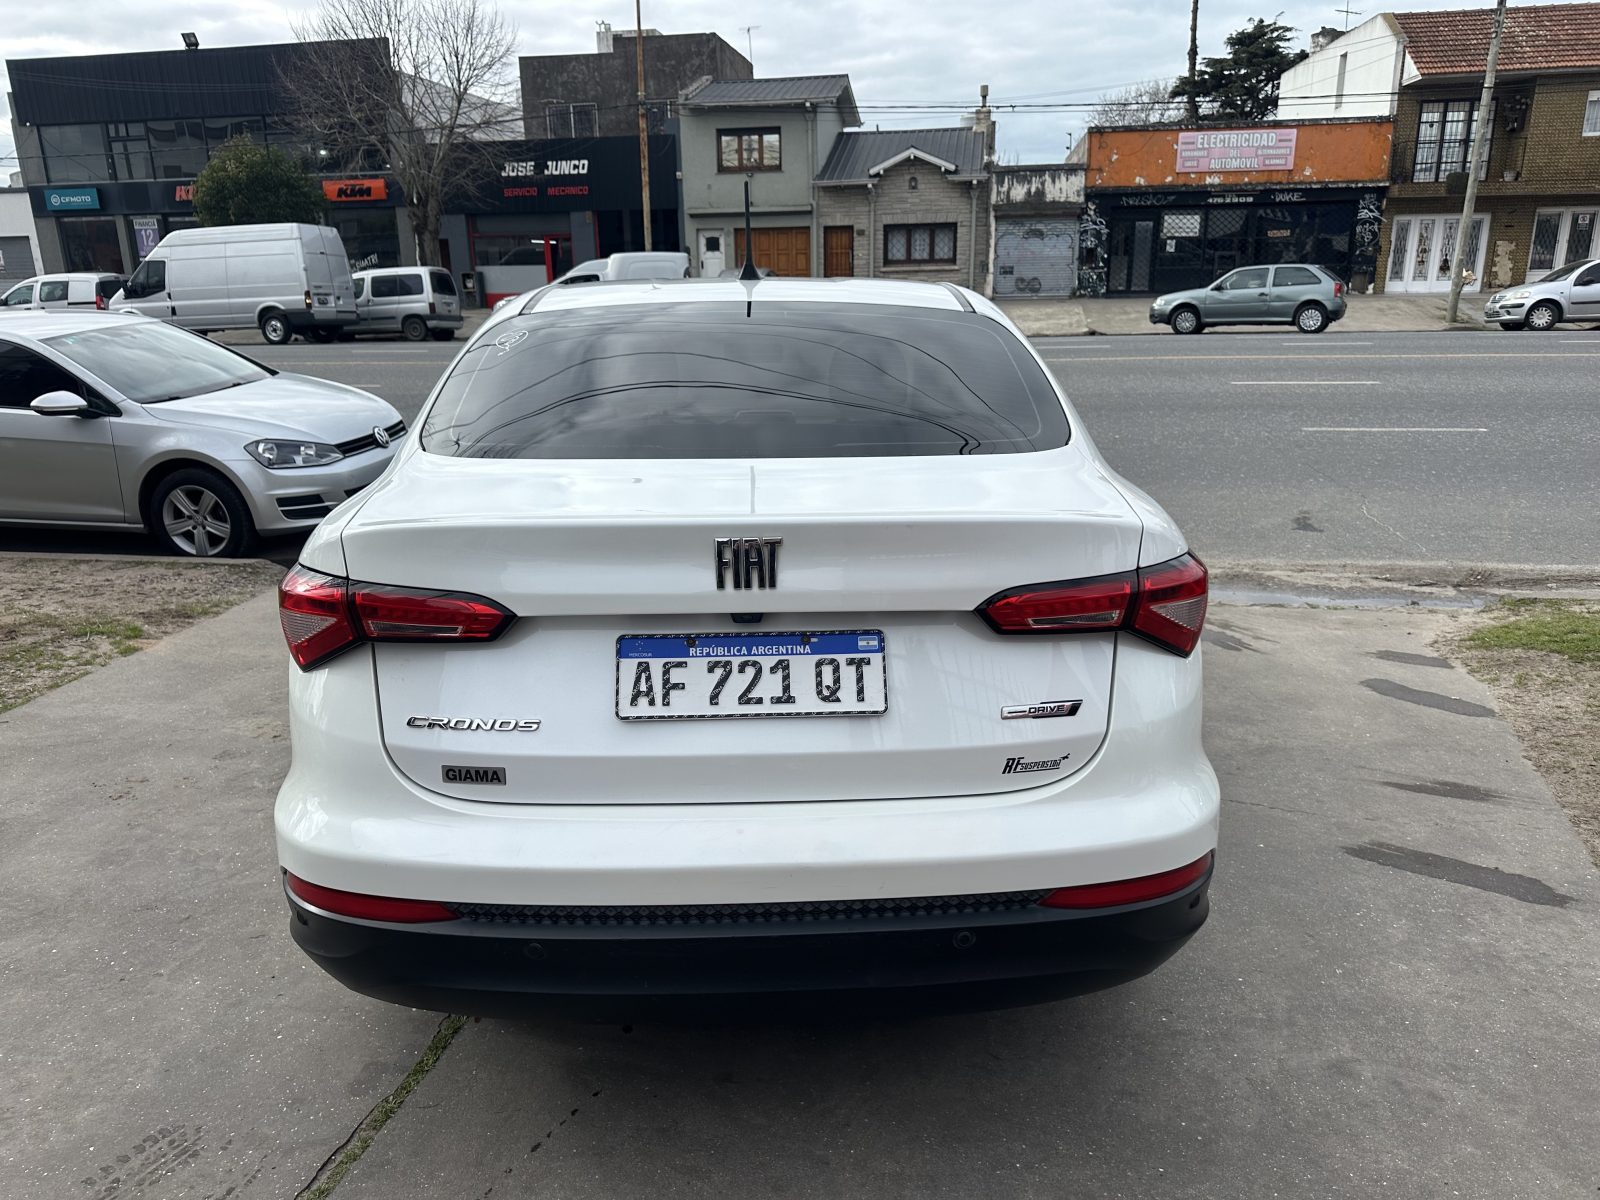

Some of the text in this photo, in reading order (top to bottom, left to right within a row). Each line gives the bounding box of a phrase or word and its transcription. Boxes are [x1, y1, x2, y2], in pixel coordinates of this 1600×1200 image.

[1196, 132, 1277, 148] ELECTRICIDAD
[1229, 149, 1241, 157] DEL
[501, 159, 589, 177] JOSE JUNCO
[1209, 158, 1259, 169] AUTOMOVIL
[337, 184, 372, 198] KTM
[503, 186, 589, 197] SERVICIO MECANICO
[60, 195, 91, 203] CFMOTO
[140, 229, 155, 246] 12
[713, 536, 783, 590] FIAT
[689, 644, 812, 657] REPÚBLICA ARGENTINA
[630, 656, 871, 706] AF 721 QT
[1028, 704, 1066, 714] DRIVE
[406, 715, 541, 731] CRONOS
[445, 768, 501, 783] GIAMA
